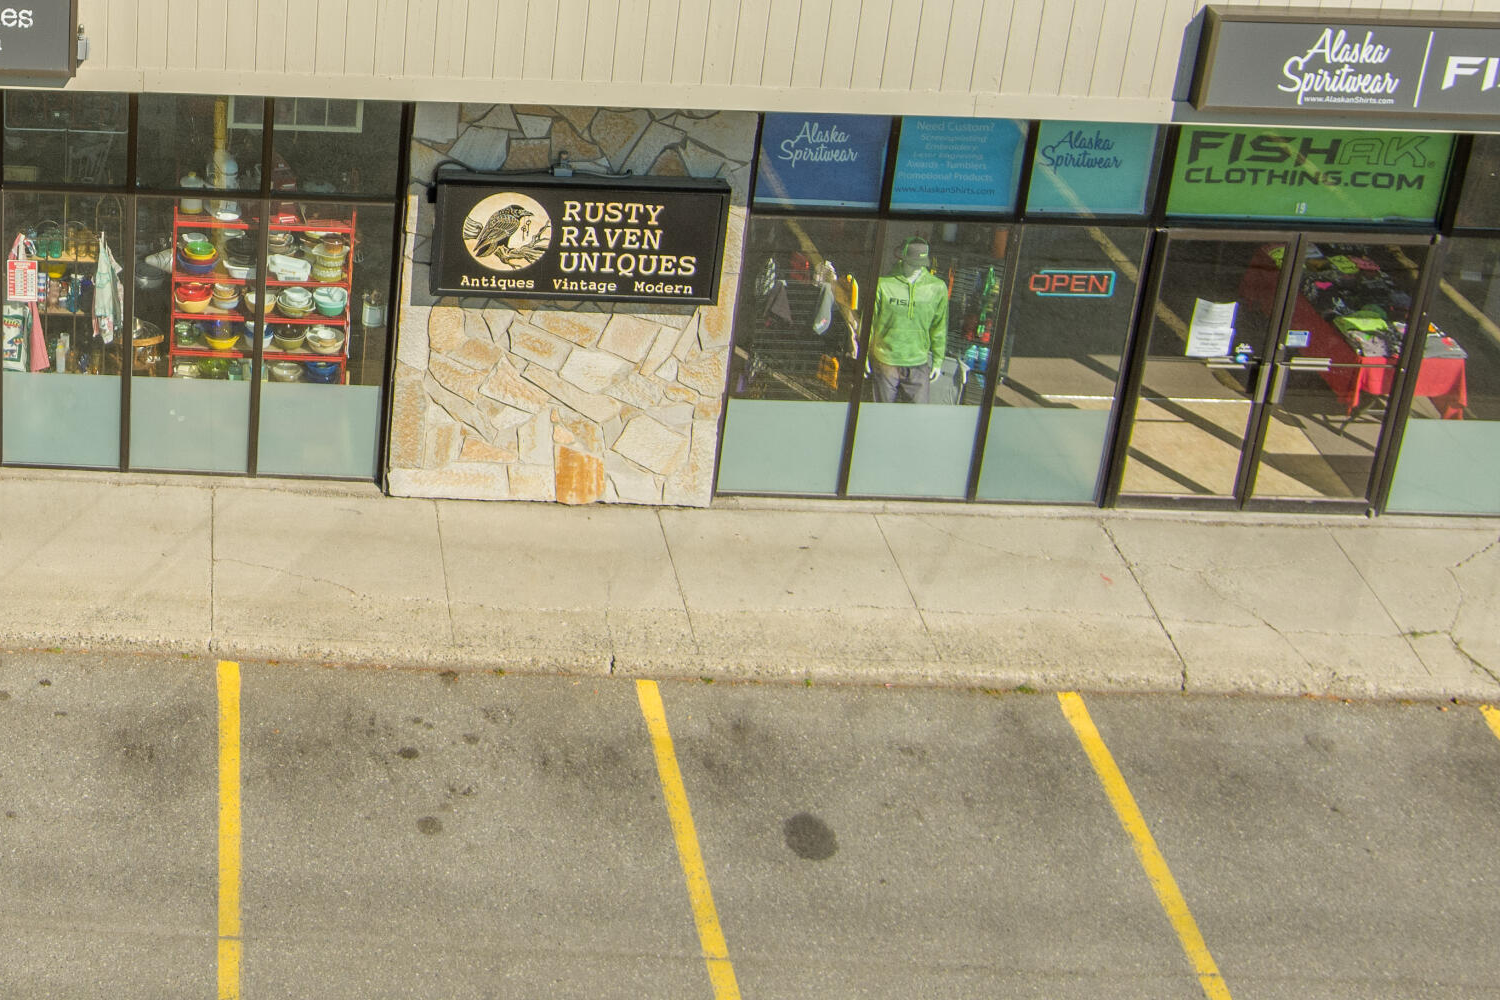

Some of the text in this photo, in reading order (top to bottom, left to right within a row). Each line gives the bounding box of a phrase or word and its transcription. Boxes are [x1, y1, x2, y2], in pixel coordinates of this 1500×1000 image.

[1303, 28, 1500, 91] Alaska FI
[1277, 56, 1399, 105] Spiritwear
[1303, 95, 1395, 105] www.AlaskanShirts.com
[794, 121, 850, 144] Alaska
[916, 120, 995, 132] Need Custom?
[1056, 130, 1114, 151] Alaska
[778, 139, 858, 168] Spiritwear
[1039, 145, 1122, 175] Spiritwear
[897, 171, 993, 182] Promotional Products
[1184, 166, 1425, 191] CLOTHING.COM
[562, 200, 665, 225] RUSTY
[560, 226, 662, 249] RAVEN
[559, 252, 697, 277] UNIQUES
[460, 275, 693, 294] Antiques Vintage Modern
[1029, 274, 1108, 292] OPEN
